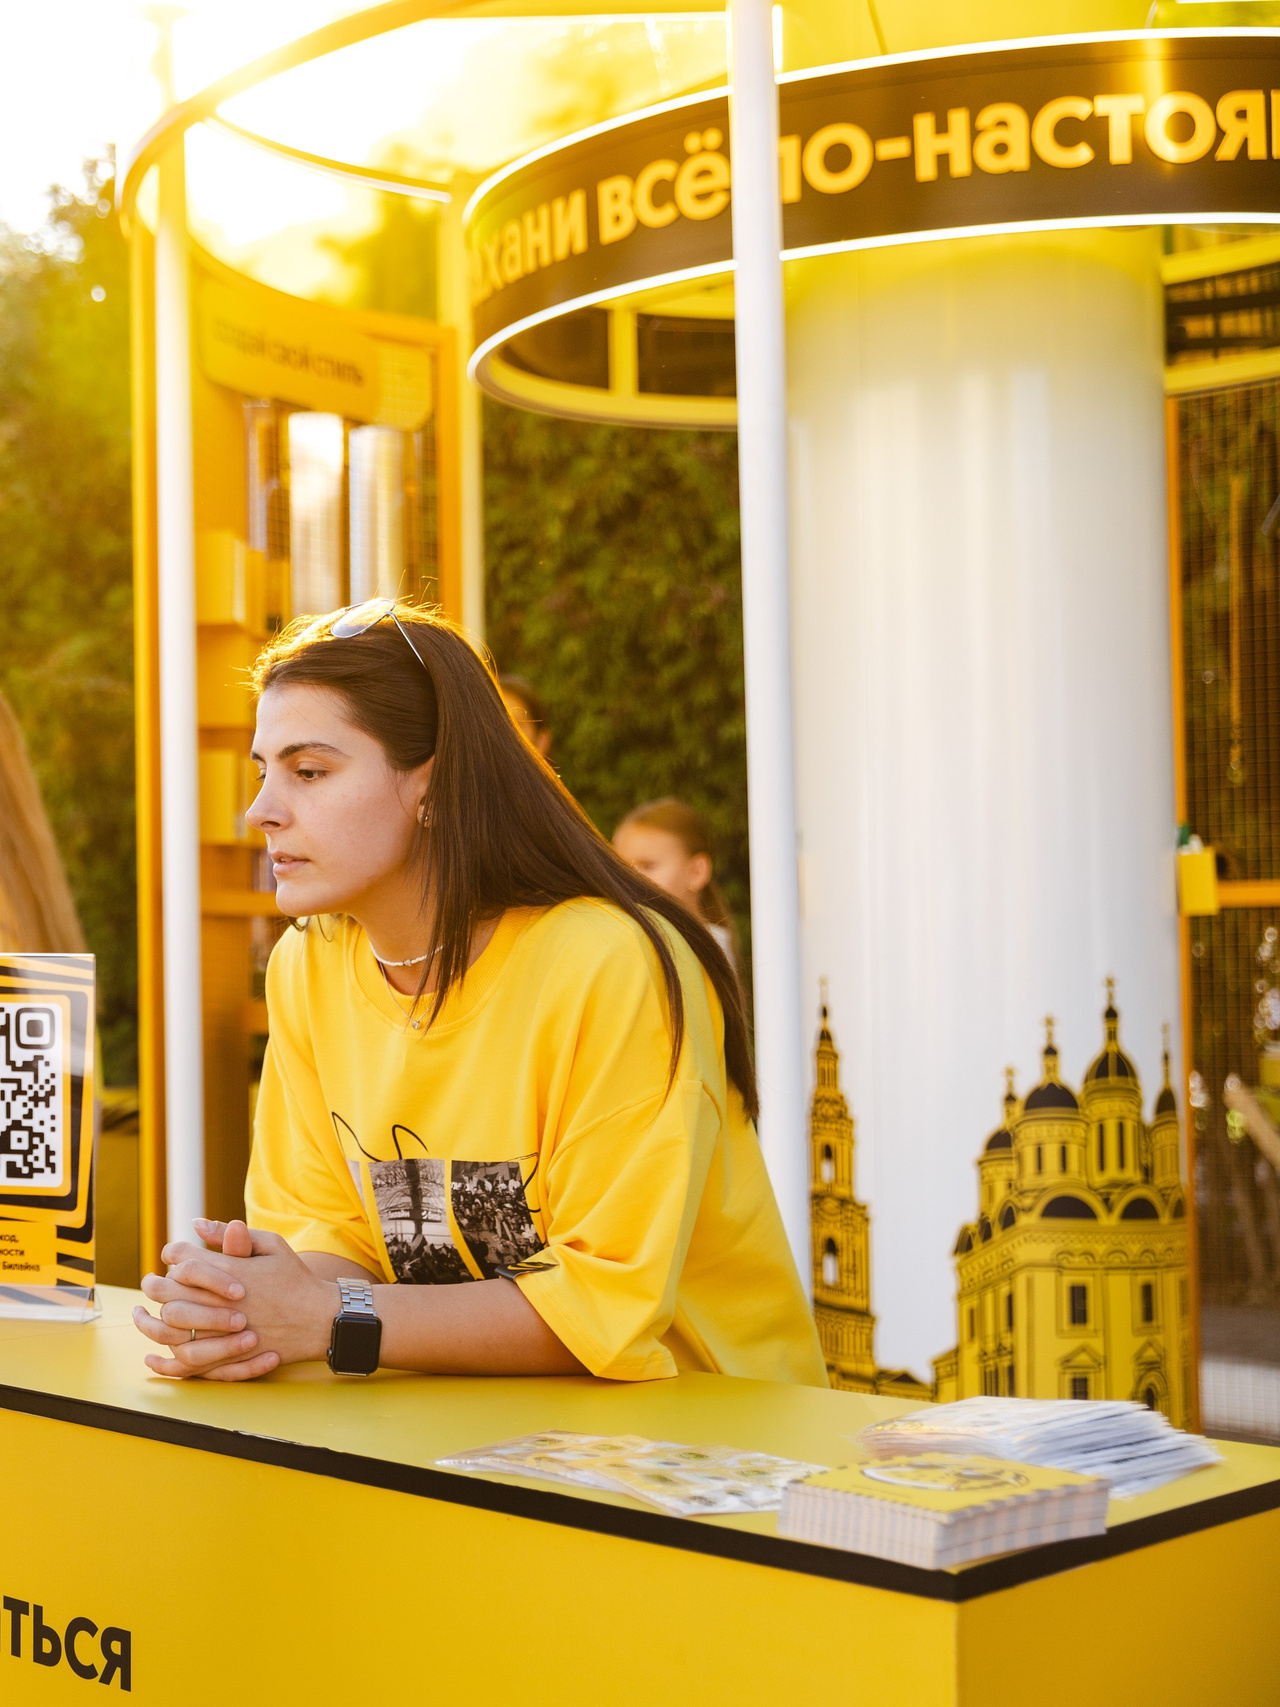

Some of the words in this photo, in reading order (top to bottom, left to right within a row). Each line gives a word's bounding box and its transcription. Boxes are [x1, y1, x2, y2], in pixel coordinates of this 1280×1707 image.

[597, 127, 732, 246] всё
[779, 88, 1280, 207] о-настоя
[2, 1260, 40, 1273] Билайна
